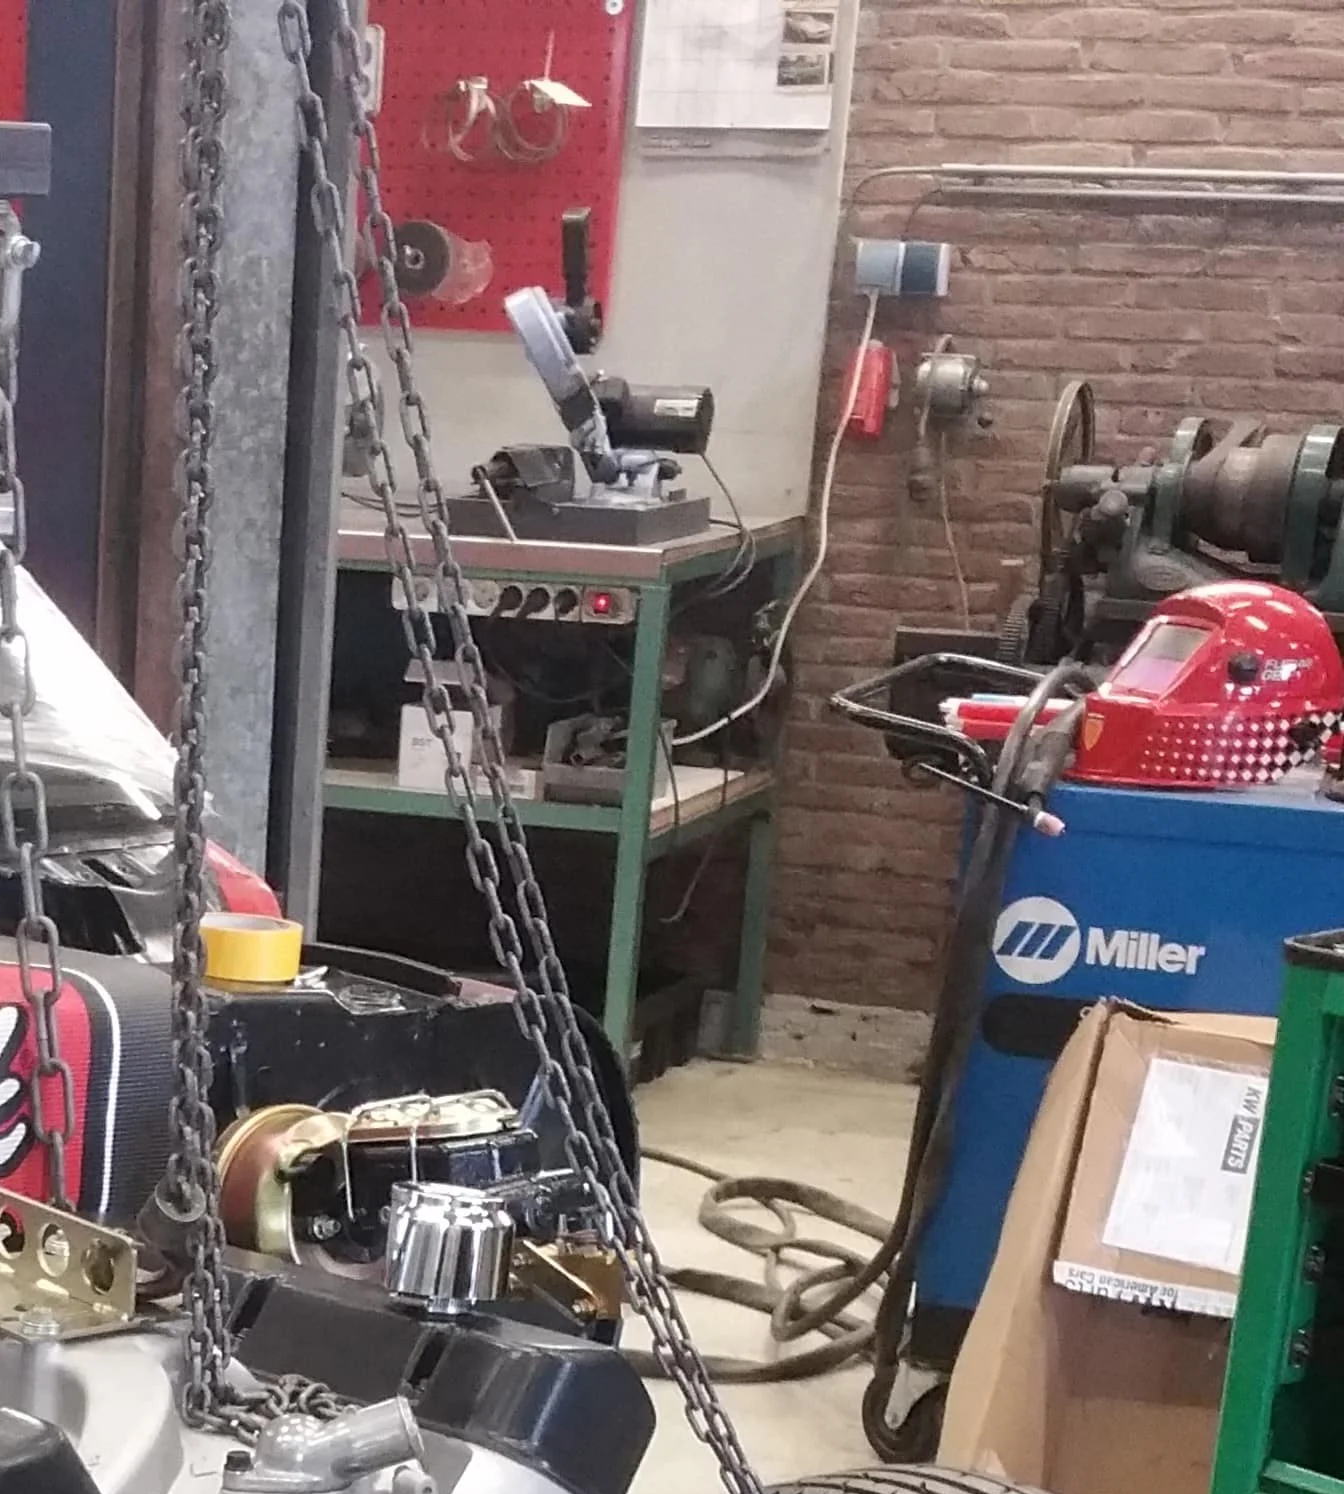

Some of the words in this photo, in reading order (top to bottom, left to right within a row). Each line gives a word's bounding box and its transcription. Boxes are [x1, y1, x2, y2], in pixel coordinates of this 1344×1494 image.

[1085, 926, 1206, 976] Miller
[1241, 1085, 1263, 1116] KW
[1224, 1116, 1257, 1171] PARTS
[1068, 1266, 1096, 1285] Cars
[1099, 1274, 1160, 1298] American
